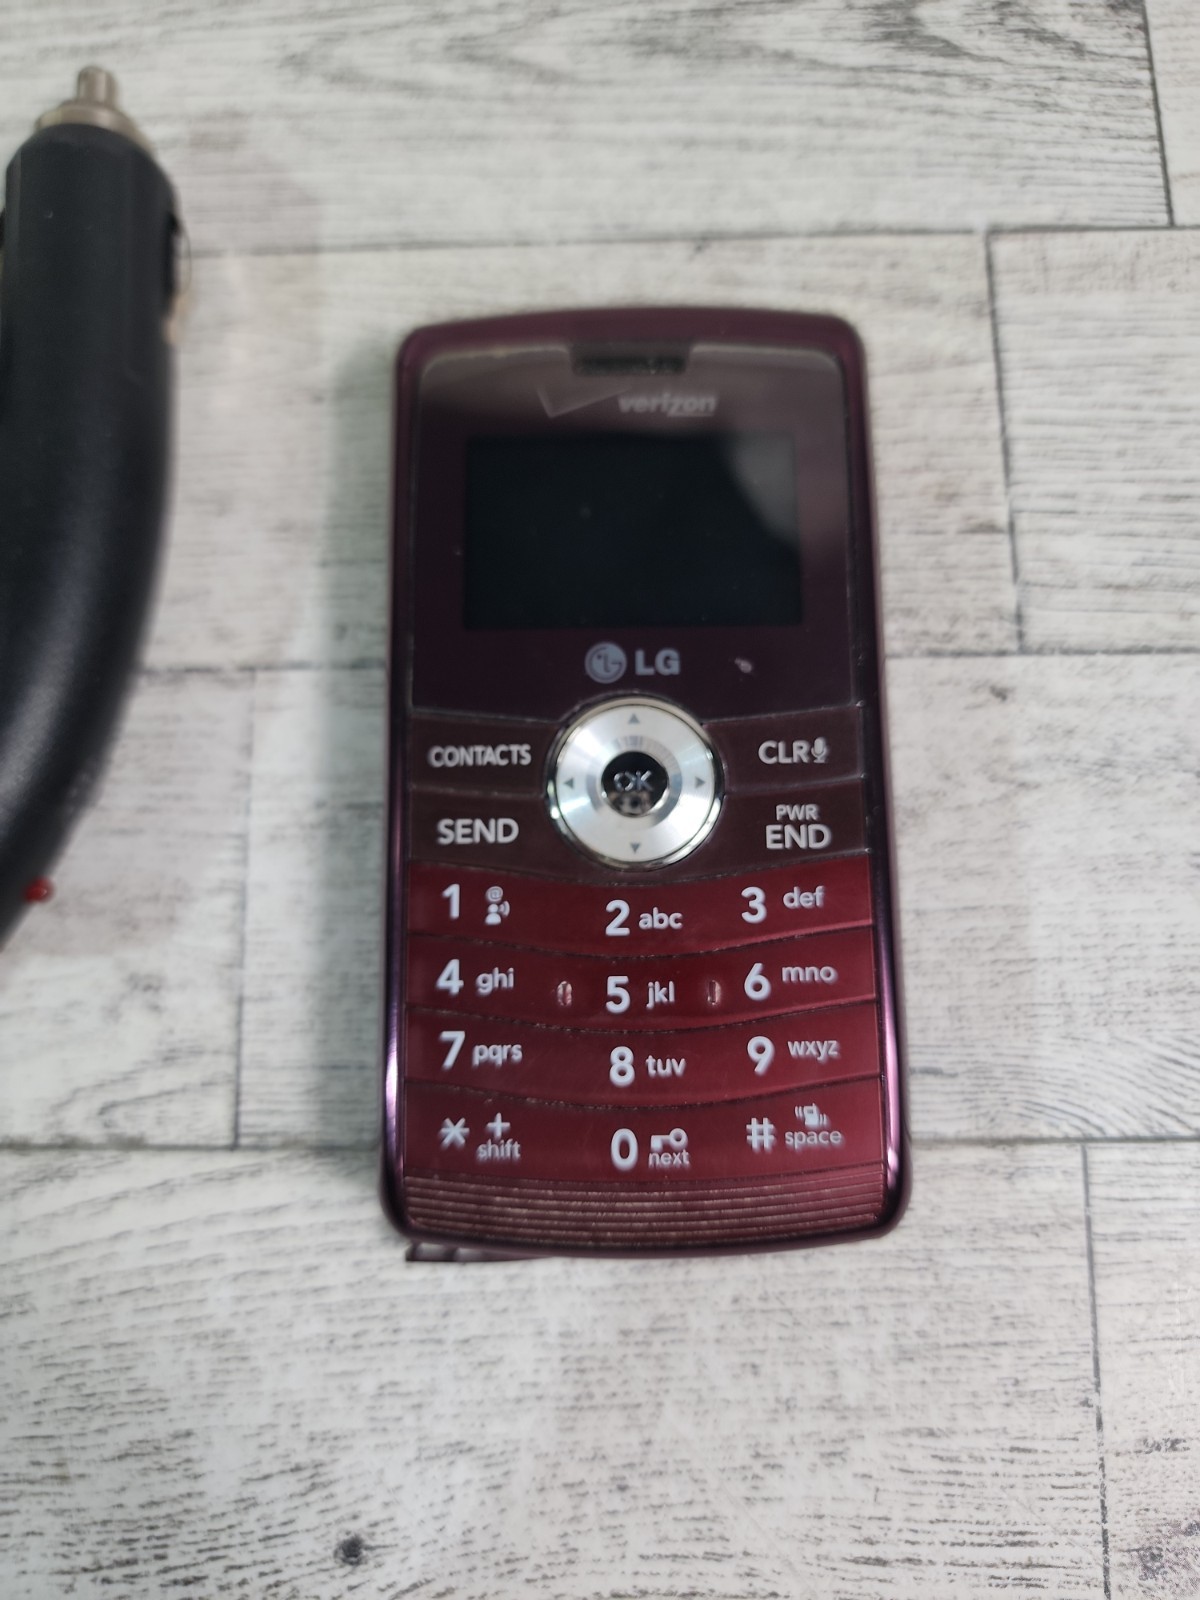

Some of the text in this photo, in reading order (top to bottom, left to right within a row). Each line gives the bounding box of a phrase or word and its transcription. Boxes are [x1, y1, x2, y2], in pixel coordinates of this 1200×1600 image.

[618, 390, 717, 417] verizon
[635, 649, 681, 675] LG
[428, 744, 532, 767] CONTACTS
[758, 741, 810, 764] CLR
[613, 770, 654, 792] OK
[776, 804, 819, 821] PWR
[437, 818, 519, 844] SEND
[765, 823, 831, 850] END
[442, 884, 461, 919] 1
[741, 886, 825, 923] 3 def
[605, 900, 683, 937] 2 abc
[436, 959, 514, 995] 4 ghi
[743, 962, 838, 1000] 6 mno
[605, 975, 675, 1013] 5 jkl
[439, 1031, 523, 1070] 7 pqrs
[747, 1036, 839, 1074] 9 wxyz
[609, 1046, 686, 1086] 8 tuv
[611, 1128, 638, 1170] 0
[746, 1117, 775, 1151] #
[784, 1128, 842, 1150] space
[476, 1141, 521, 1161] shift
[648, 1149, 690, 1167] next
